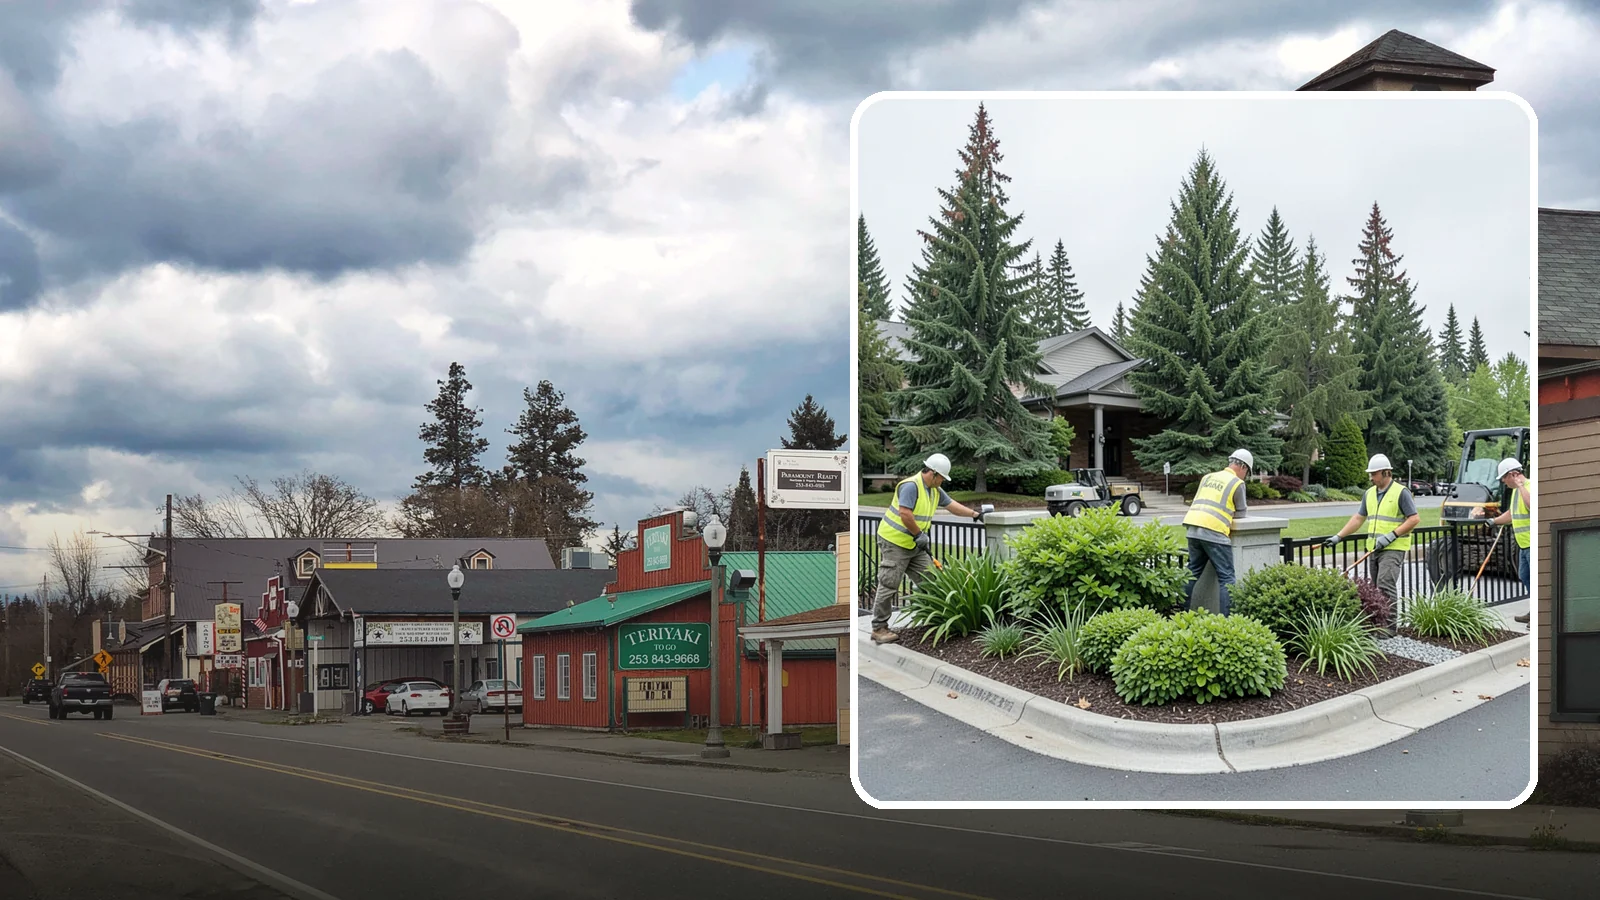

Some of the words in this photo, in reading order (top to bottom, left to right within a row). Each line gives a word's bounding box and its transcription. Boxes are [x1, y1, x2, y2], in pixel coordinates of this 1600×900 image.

[781, 471, 815, 479] PARAMOUNT
[624, 627, 702, 646] TERIYAKI
[629, 654, 648, 664] 253
[651, 653, 700, 664] 843-9668
